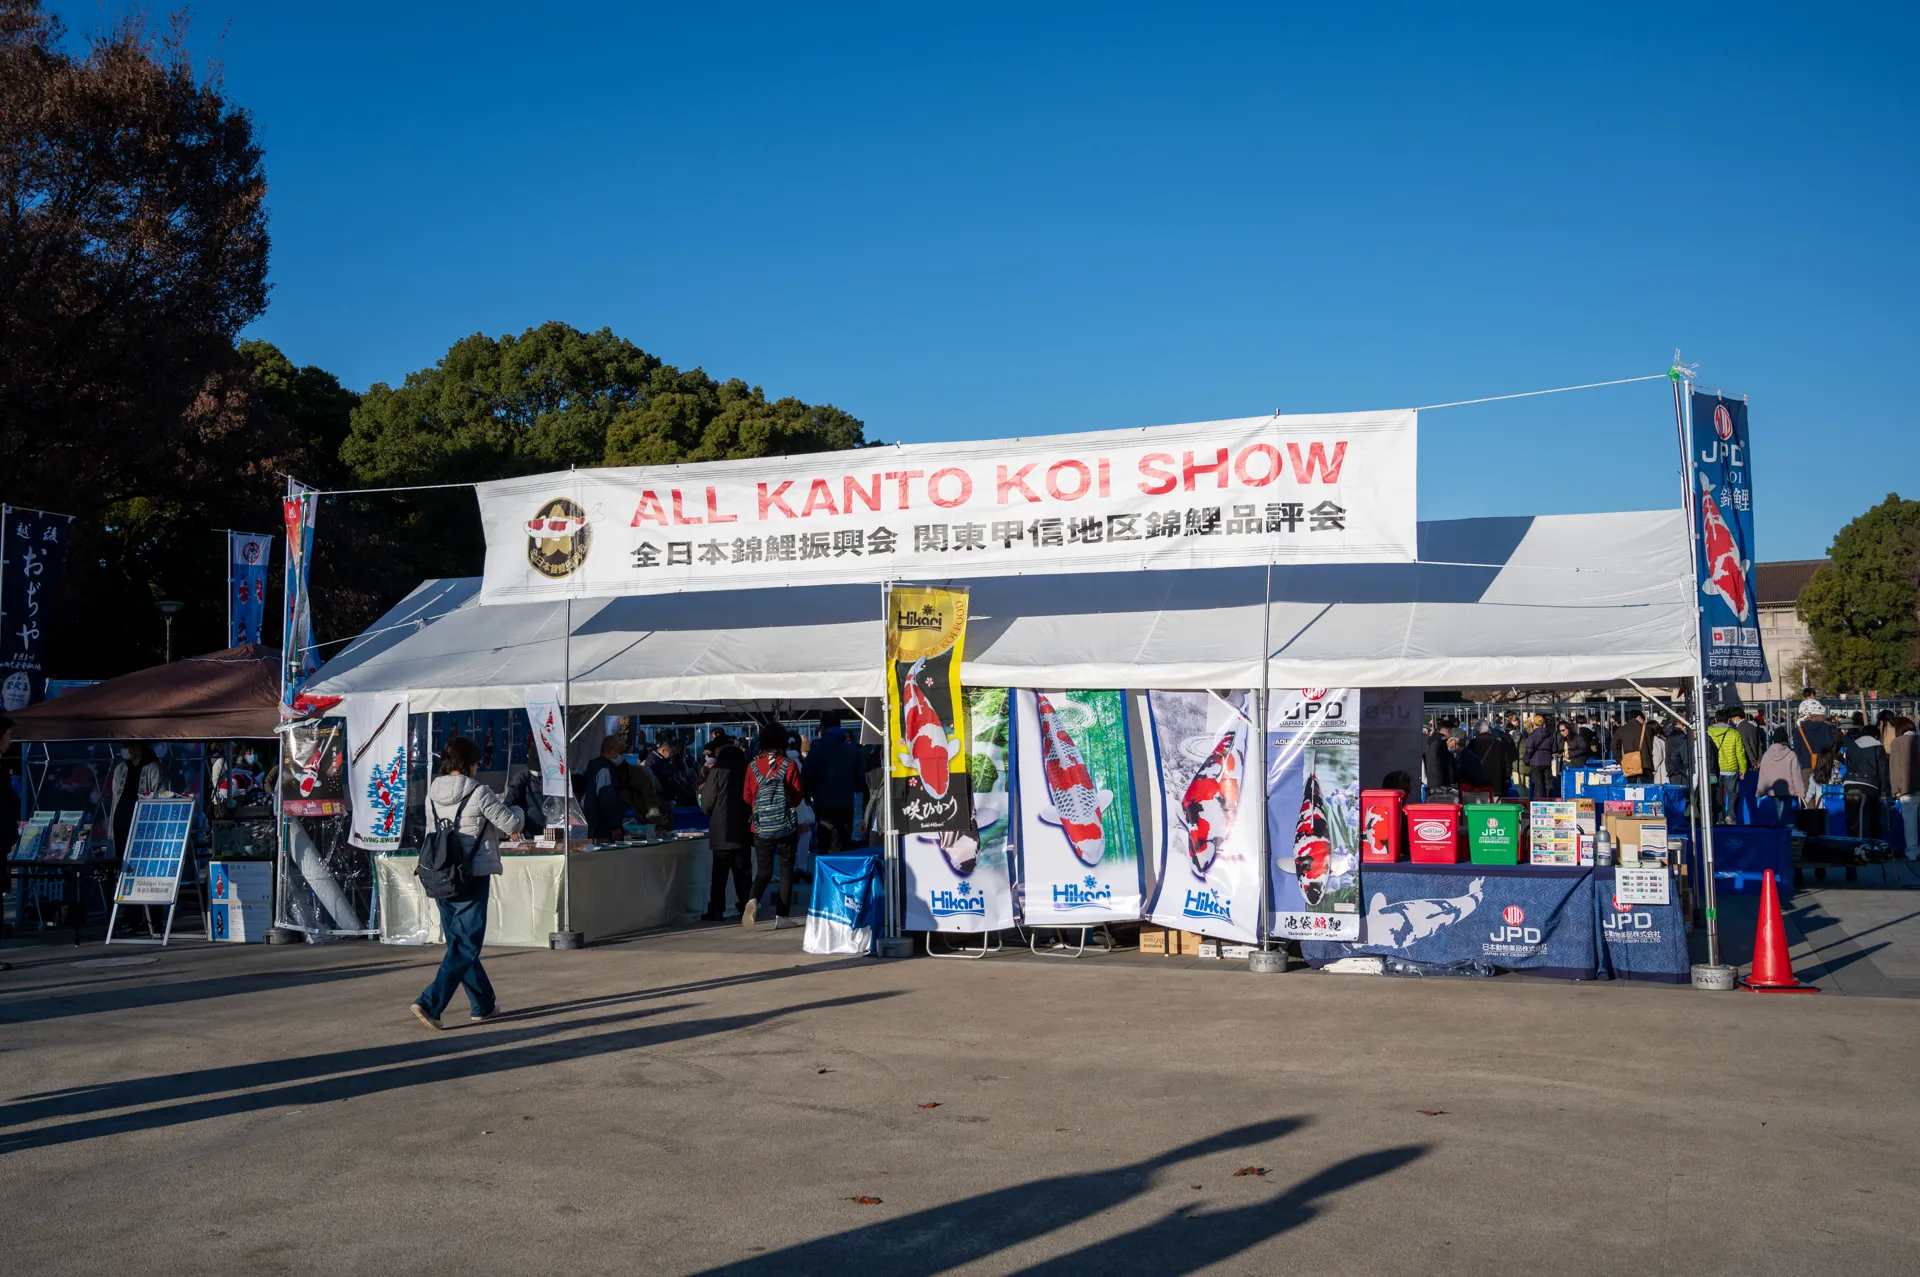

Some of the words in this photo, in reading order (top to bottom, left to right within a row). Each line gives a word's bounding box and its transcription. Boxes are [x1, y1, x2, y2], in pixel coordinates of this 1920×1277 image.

[1702, 440, 1745, 467] JPD
[630, 486, 738, 528] ALL
[757, 467, 973, 521] KANTO
[996, 457, 1110, 505] KOI
[1137, 440, 1349, 496] SHOW
[1726, 471, 1743, 484] OI
[630, 526, 899, 569] 全日本錦鯉振興会
[913, 500, 1349, 554] 関東甲信地区錦鯉品評会
[16, 545, 48, 650] おぢや
[897, 610, 943, 627] Hikari
[953, 600, 966, 632] FOOD
[1284, 701, 1343, 720] JPD
[1632, 791, 1637, 799] 4
[902, 795, 959, 821] 咲ひかり
[1481, 828, 1505, 837] JPD
[931, 889, 985, 910] Hikari
[1053, 883, 1112, 904] Hikari
[1603, 912, 1653, 930] JPD
[1489, 925, 1541, 944] JPD
